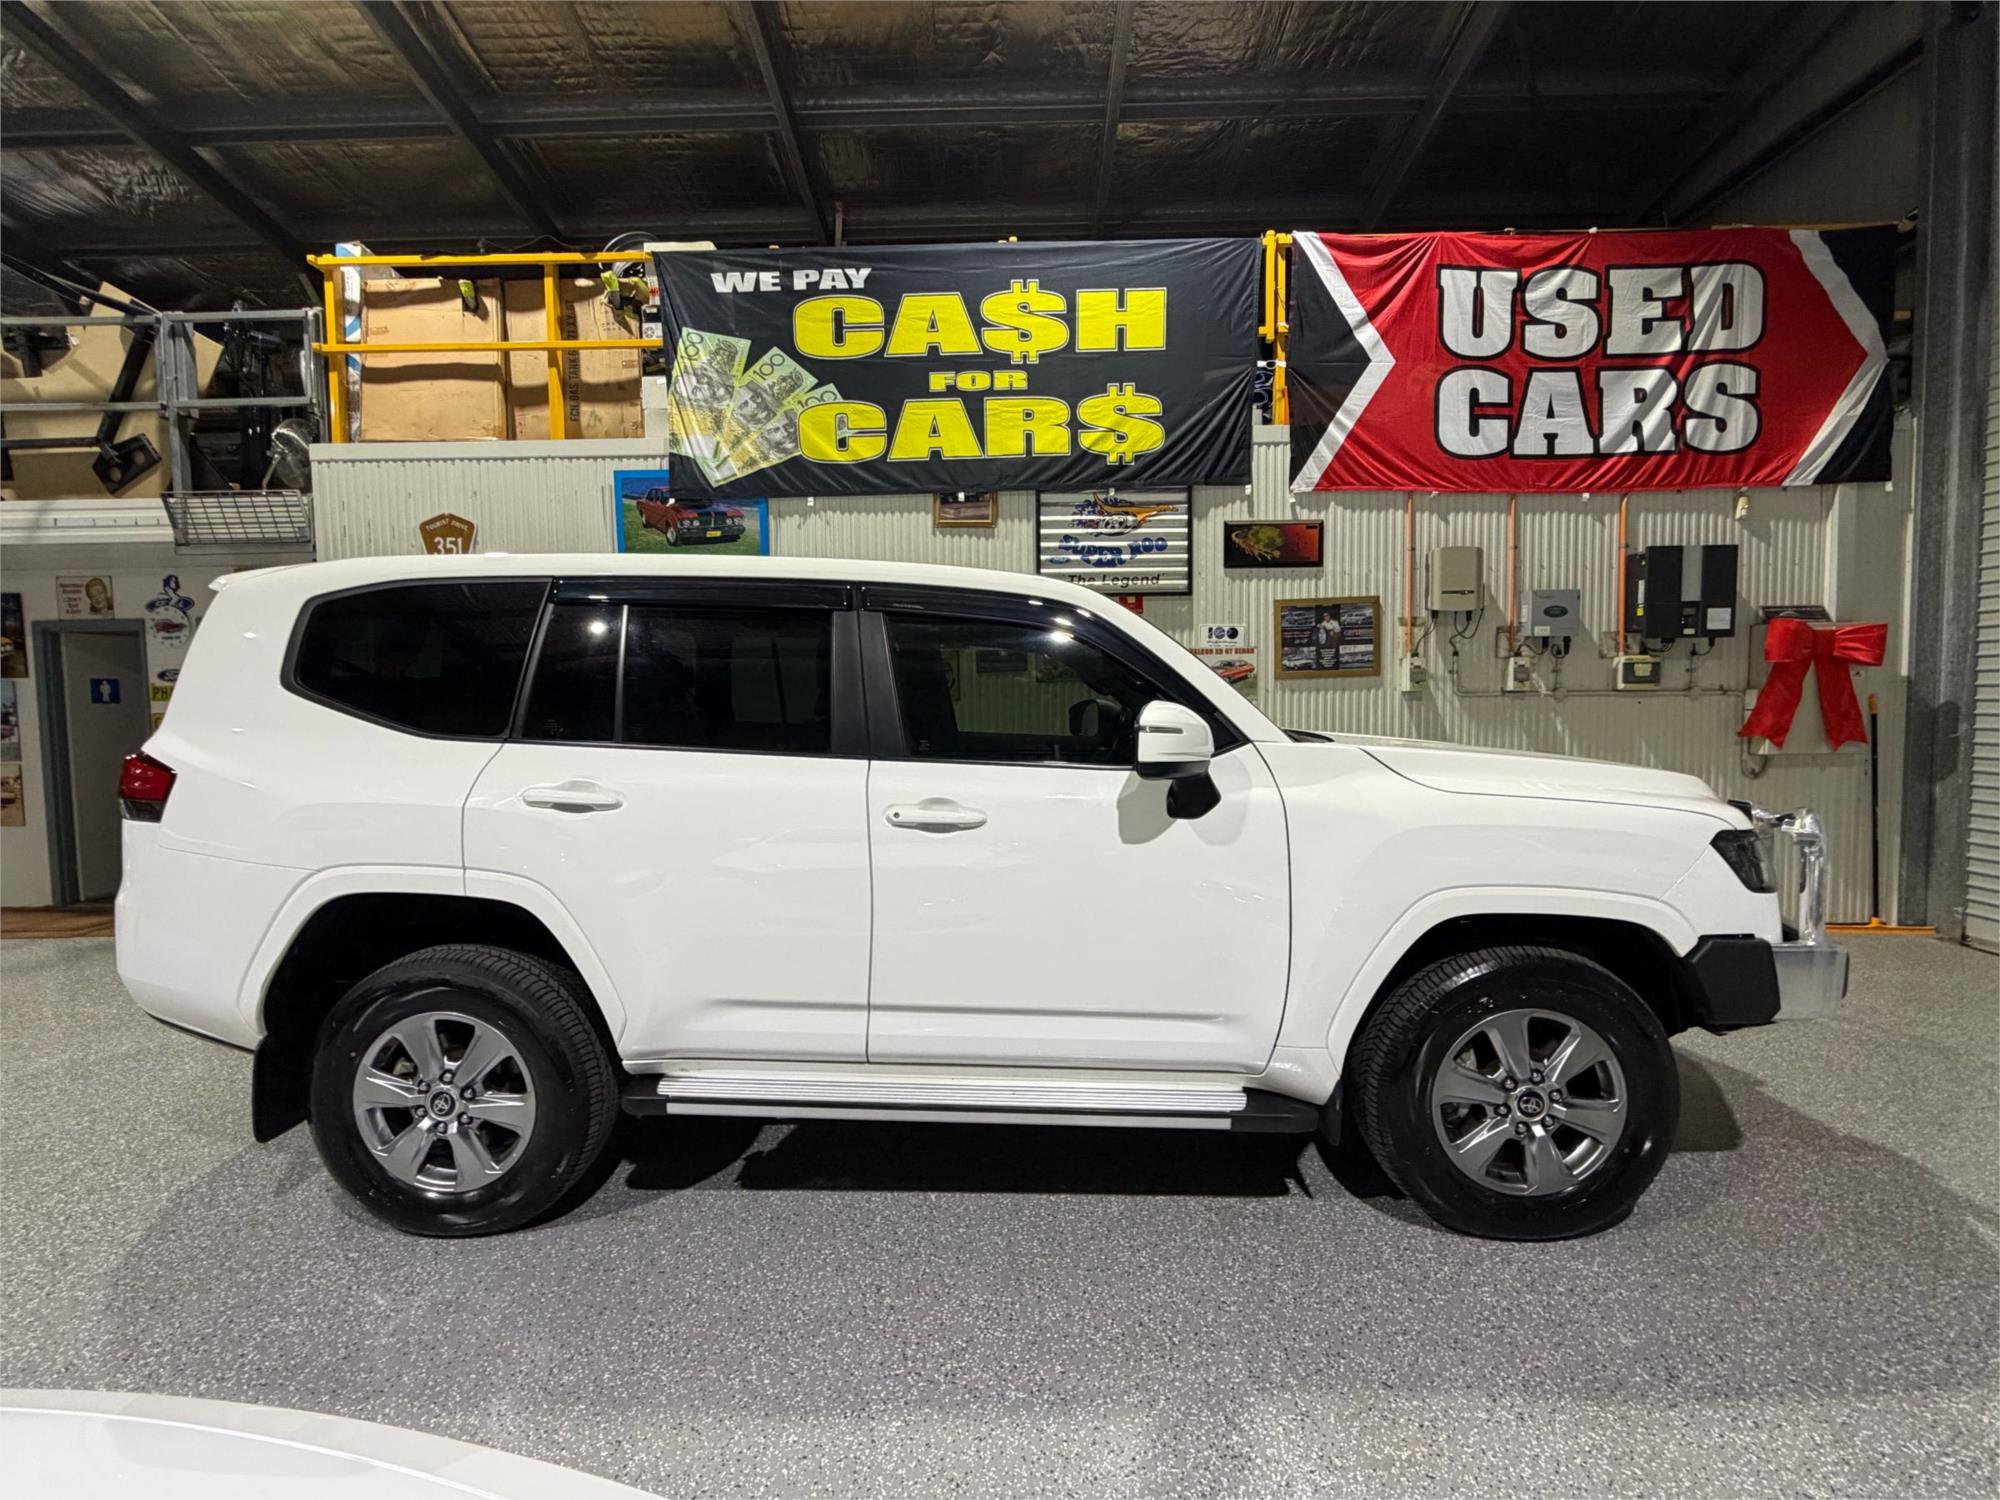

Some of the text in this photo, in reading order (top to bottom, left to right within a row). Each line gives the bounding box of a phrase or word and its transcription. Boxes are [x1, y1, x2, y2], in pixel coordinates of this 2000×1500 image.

[710, 266, 873, 294] WE PAY
[793, 279, 1167, 364] CA$H
[1437, 261, 1766, 359] USED
[752, 352, 786, 382] 100
[928, 370, 1029, 392] FOR
[797, 382, 1168, 466] CAR$
[1436, 362, 1761, 458] CARS
[433, 536, 463, 555] 351
